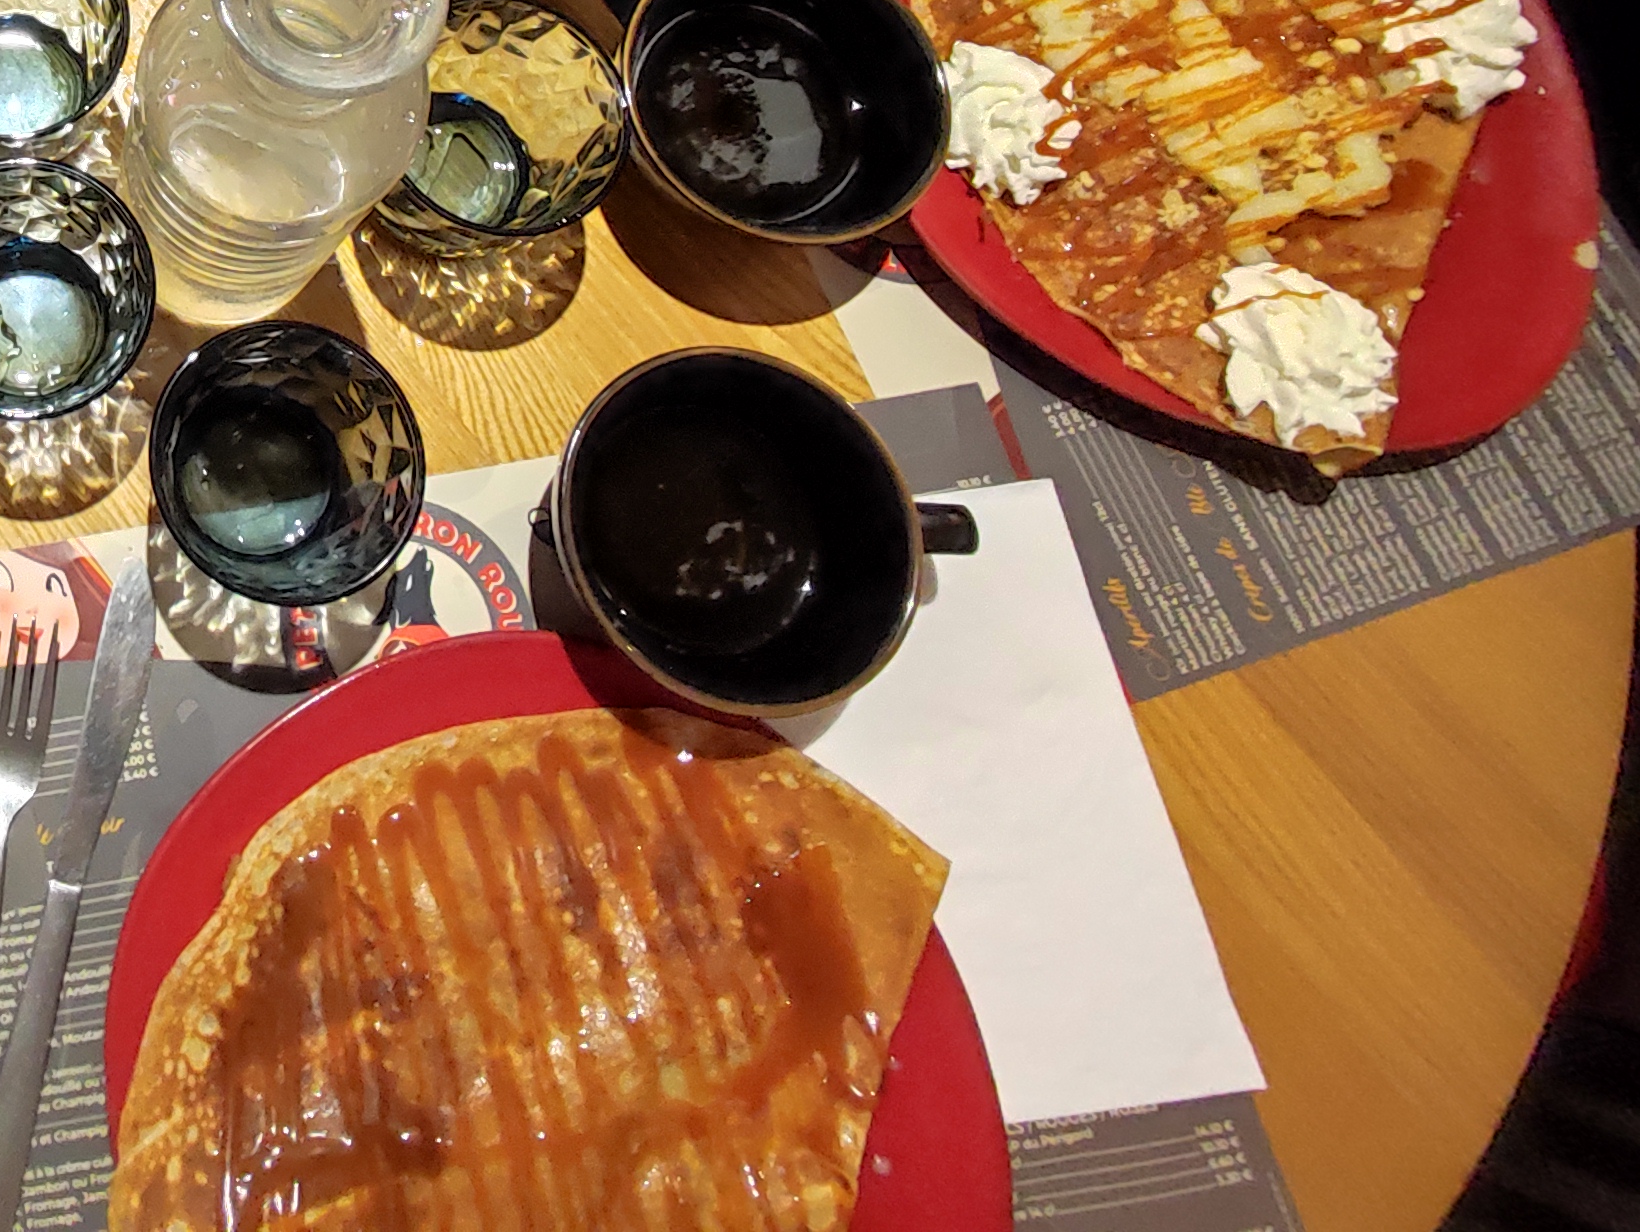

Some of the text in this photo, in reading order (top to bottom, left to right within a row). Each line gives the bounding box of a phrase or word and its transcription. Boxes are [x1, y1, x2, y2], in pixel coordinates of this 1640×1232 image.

[1202, 460, 1239, 513] GLUTEN
[1171, 525, 1191, 554] cidre
[1233, 513, 1259, 551] SANS
[1120, 551, 1146, 591] Breton
[1129, 544, 1151, 577] blanc
[1187, 554, 1200, 569] de
[1195, 571, 1215, 598] base
[1173, 628, 1201, 671] Martini
[1207, 616, 1234, 660] Whisky
[1213, 607, 1246, 655] Cocktail
